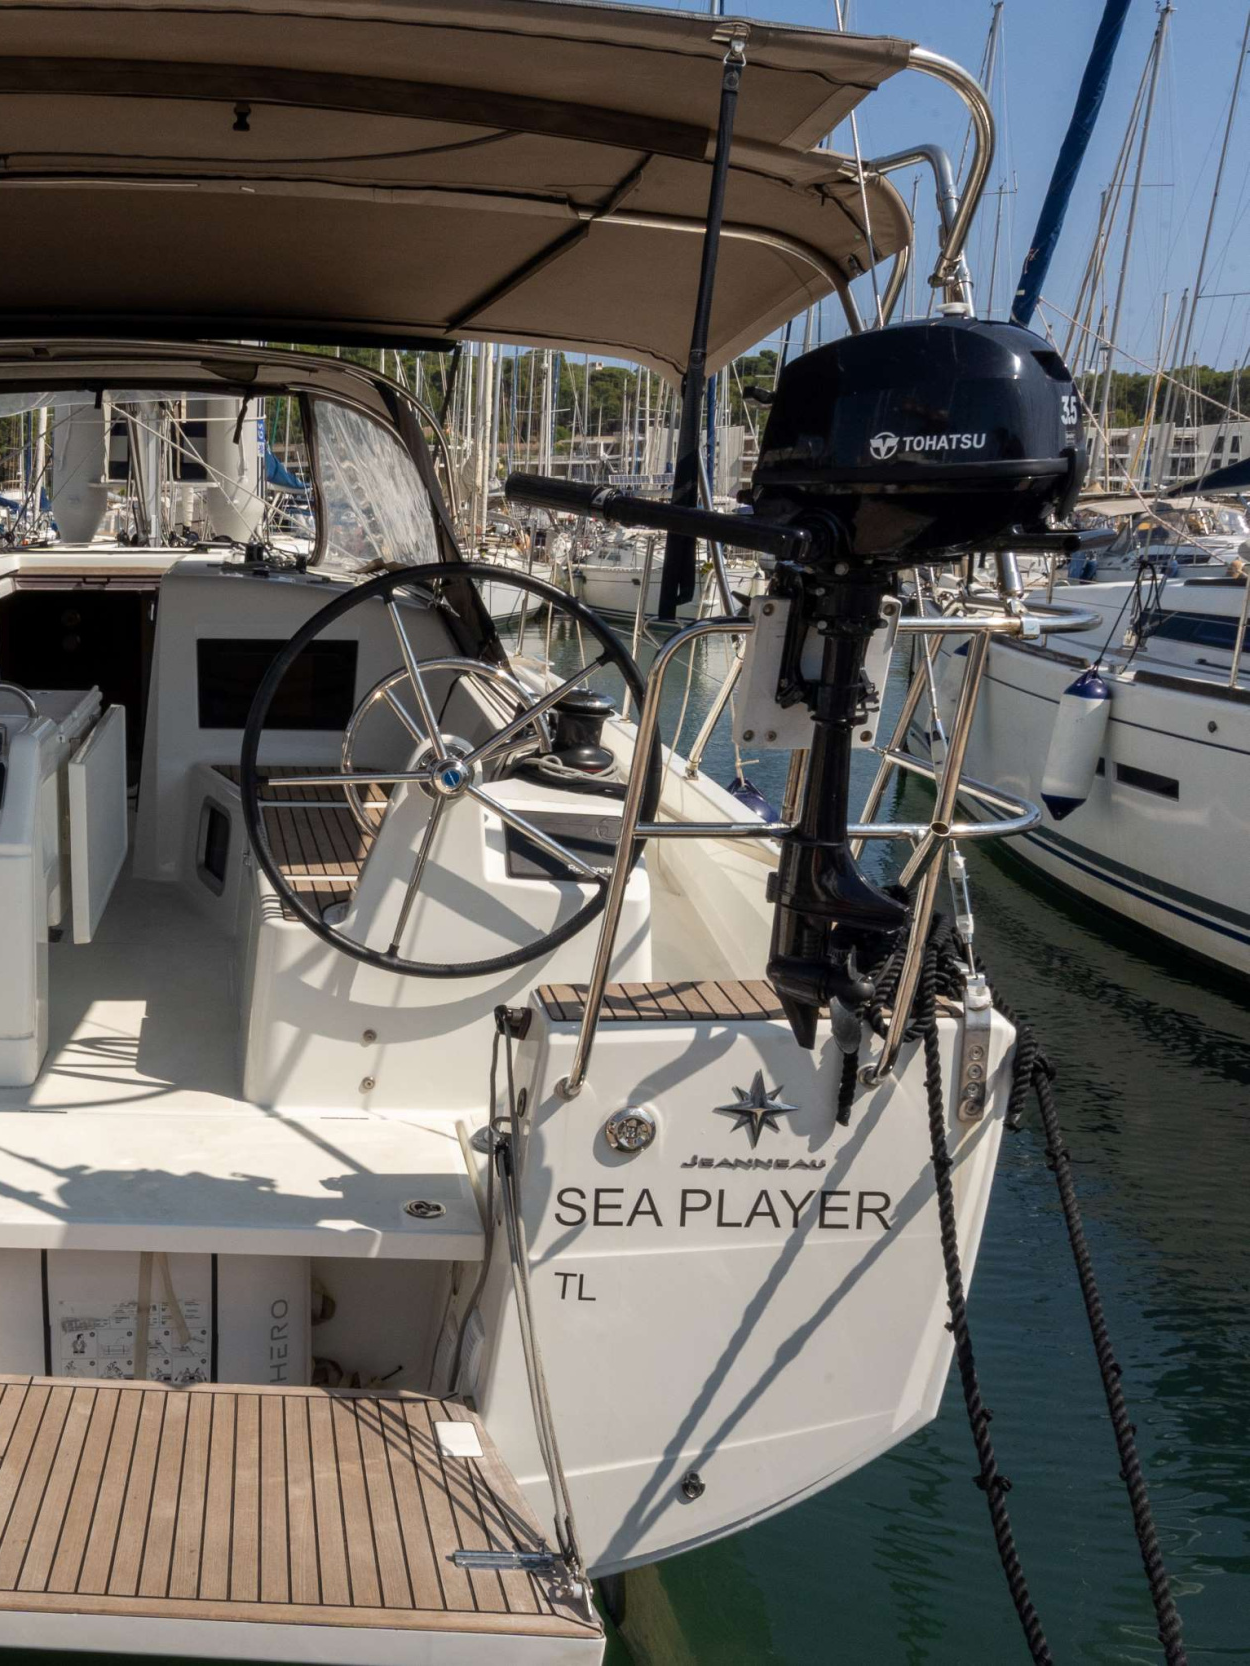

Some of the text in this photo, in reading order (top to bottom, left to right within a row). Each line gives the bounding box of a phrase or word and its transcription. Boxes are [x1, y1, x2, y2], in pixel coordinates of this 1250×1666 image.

[902, 433, 987, 452] TOHATSU
[680, 1154, 827, 1171] JEANNEAU
[554, 1187, 892, 1231] SEA PLAYER
[554, 1272, 597, 1301] TL
[270, 1299, 289, 1383] HERO
